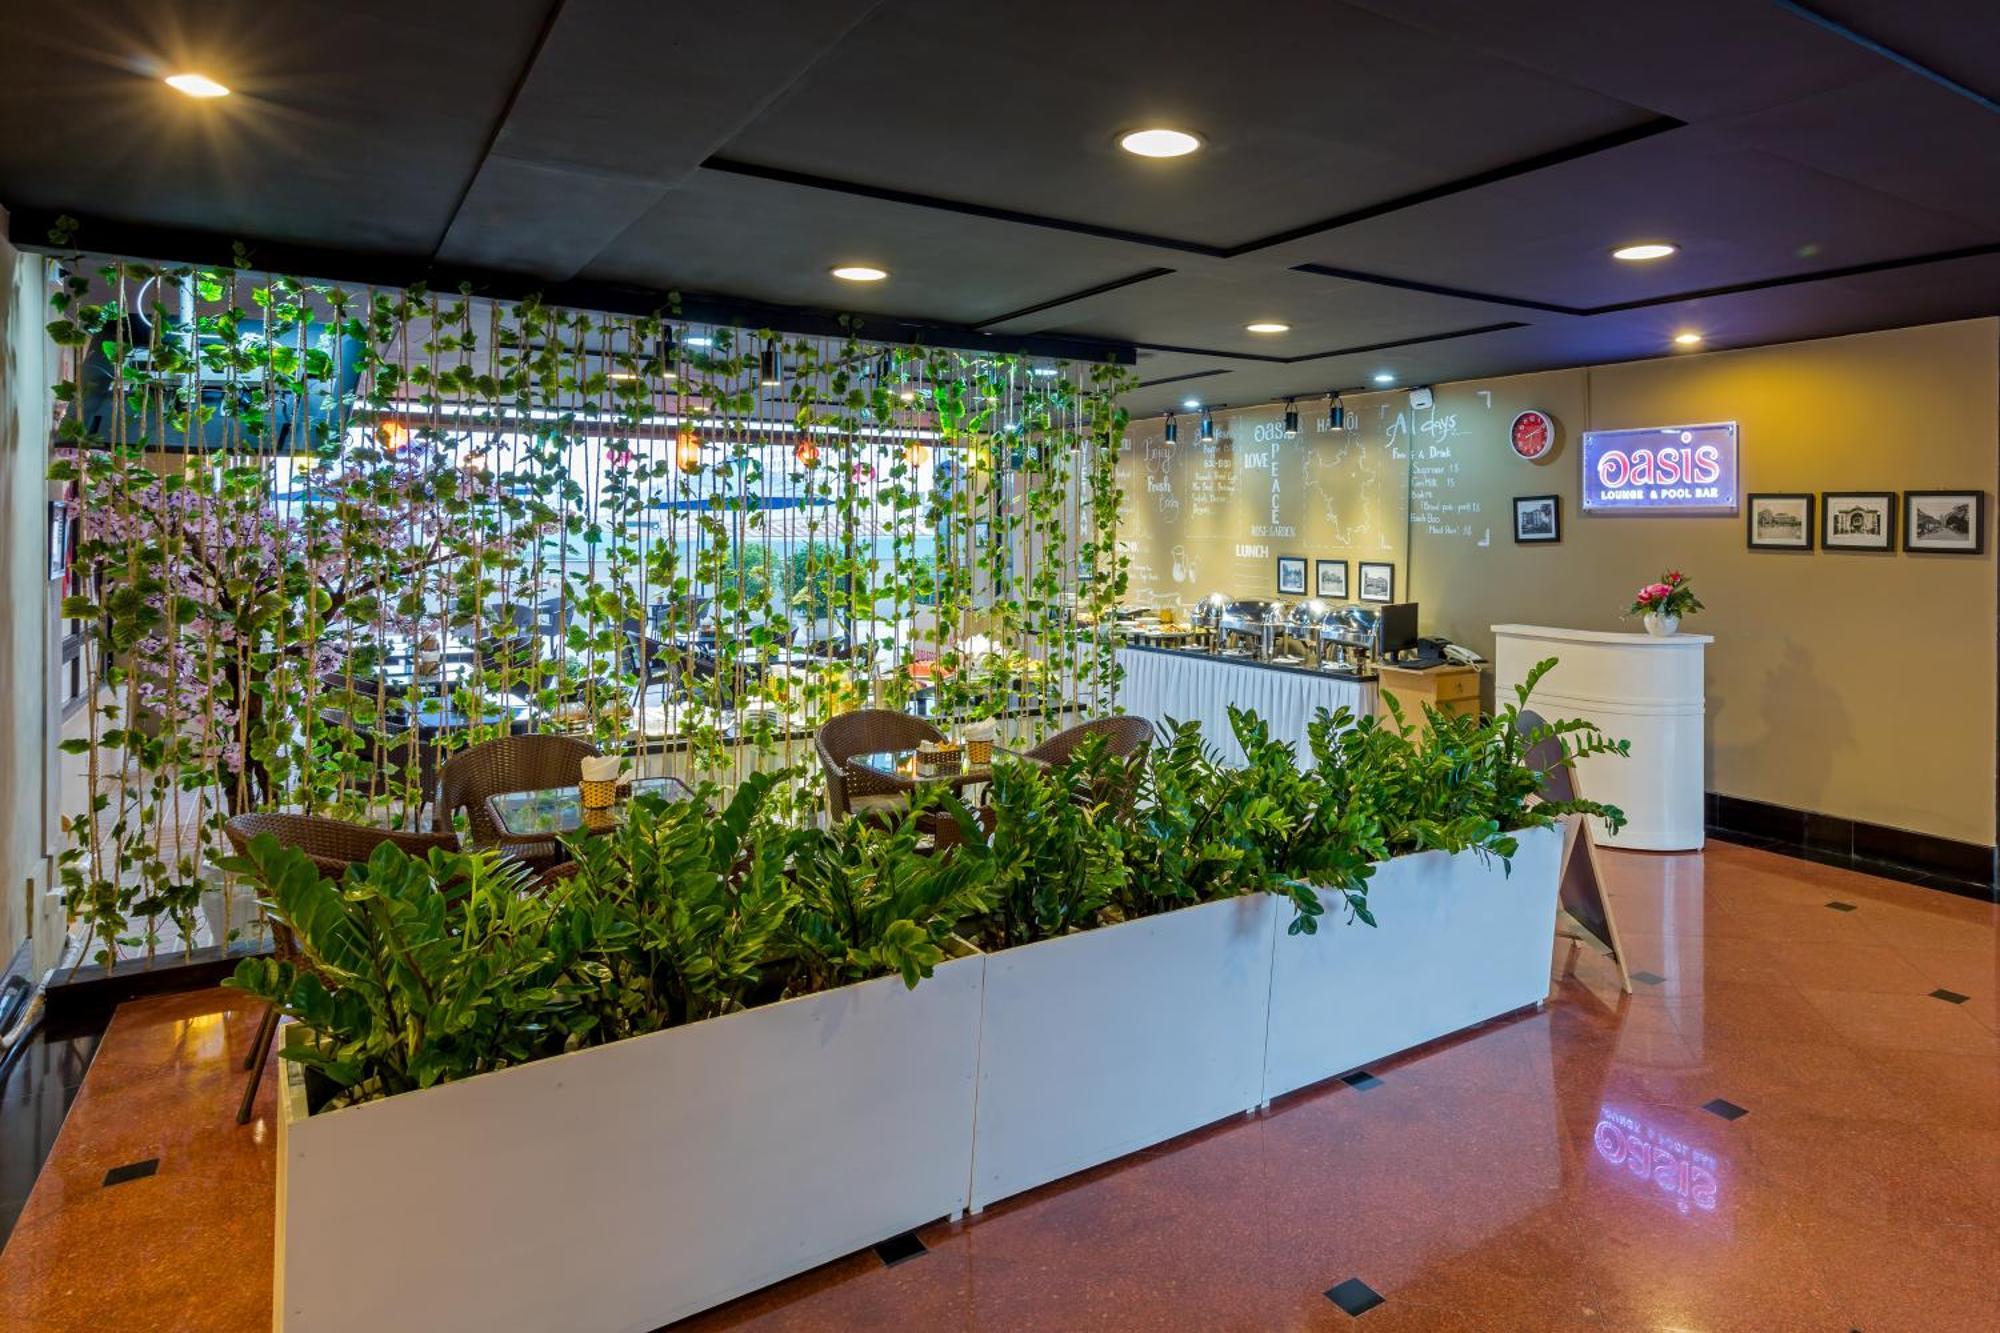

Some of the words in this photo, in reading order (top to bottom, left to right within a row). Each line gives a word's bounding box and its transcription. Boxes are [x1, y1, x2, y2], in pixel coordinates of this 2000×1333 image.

[1244, 452, 1269, 469] LOVE
[1597, 431, 1720, 488] oasis
[1600, 489, 1644, 500] LOUNGE
[1650, 490, 1658, 500] &
[1661, 488, 1692, 499] POOL
[1695, 487, 1718, 498] BAR
[1236, 543, 1269, 558] LUNCH
